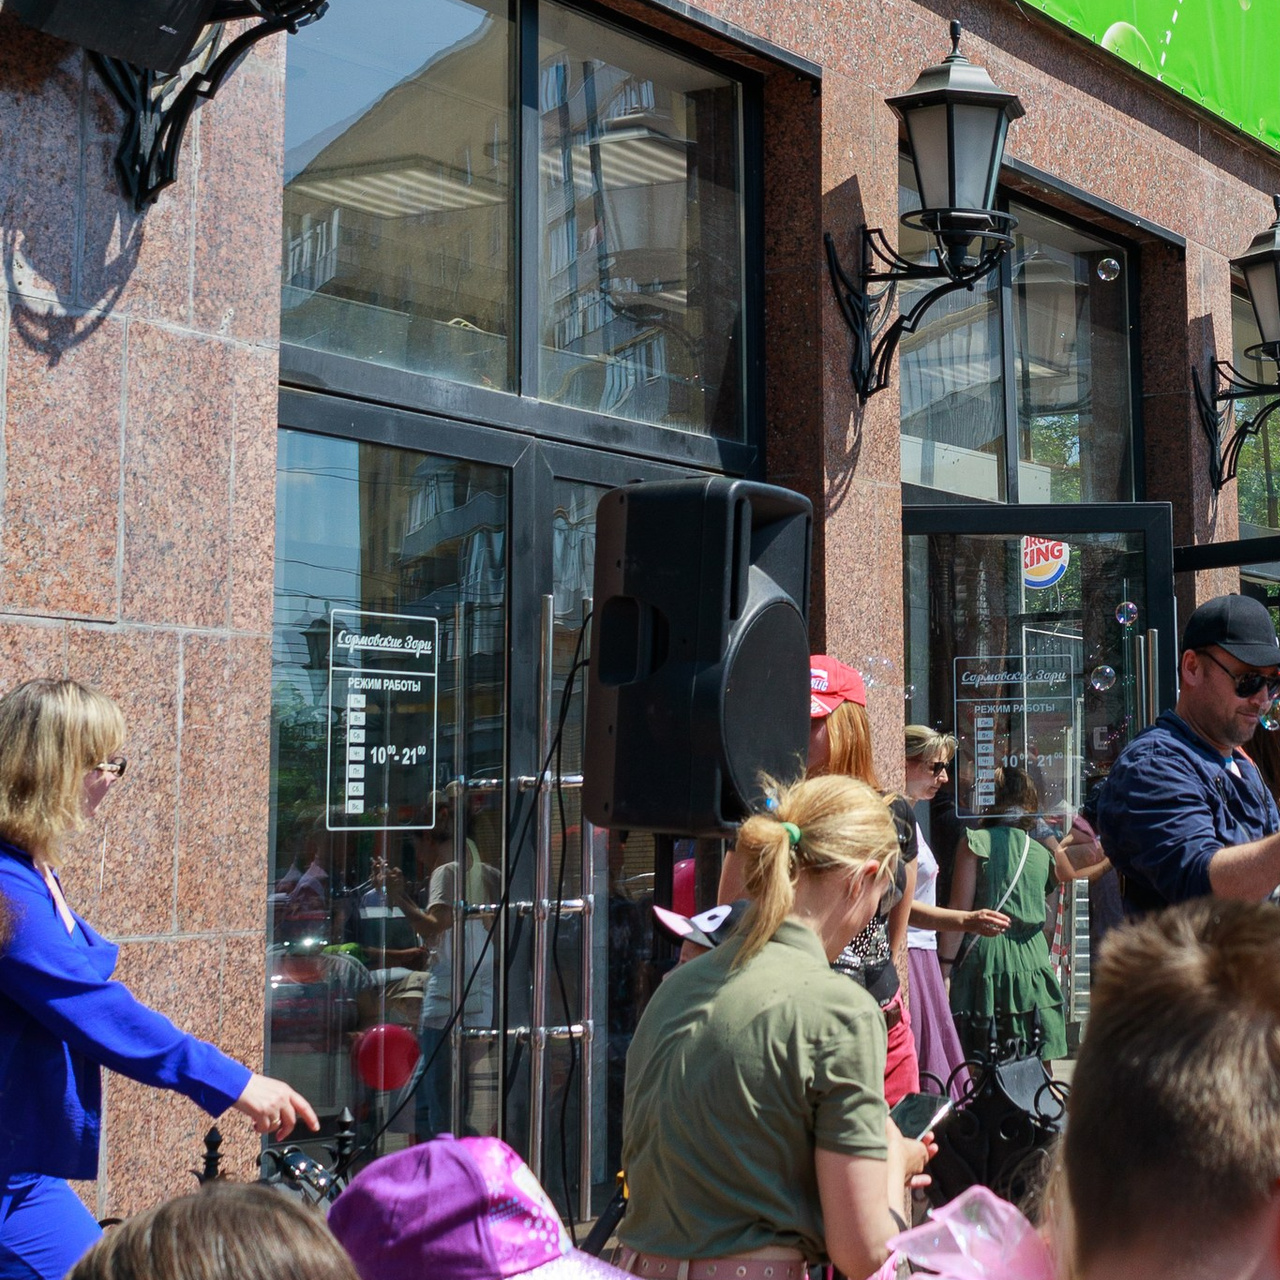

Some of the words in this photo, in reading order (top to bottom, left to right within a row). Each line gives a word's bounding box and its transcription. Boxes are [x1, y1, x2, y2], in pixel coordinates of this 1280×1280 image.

[337, 629, 403, 654] Сормовские
[403, 635, 433, 659] Зори
[347, 677, 382, 691] РЕЖИМ
[383, 678, 421, 693] РАБОТЫ
[961, 670, 1033, 688] Сормовские
[1035, 669, 1067, 686] Зори
[974, 704, 1011, 714] РЕЖИМ
[1013, 703, 1055, 713] РАБОТЫ
